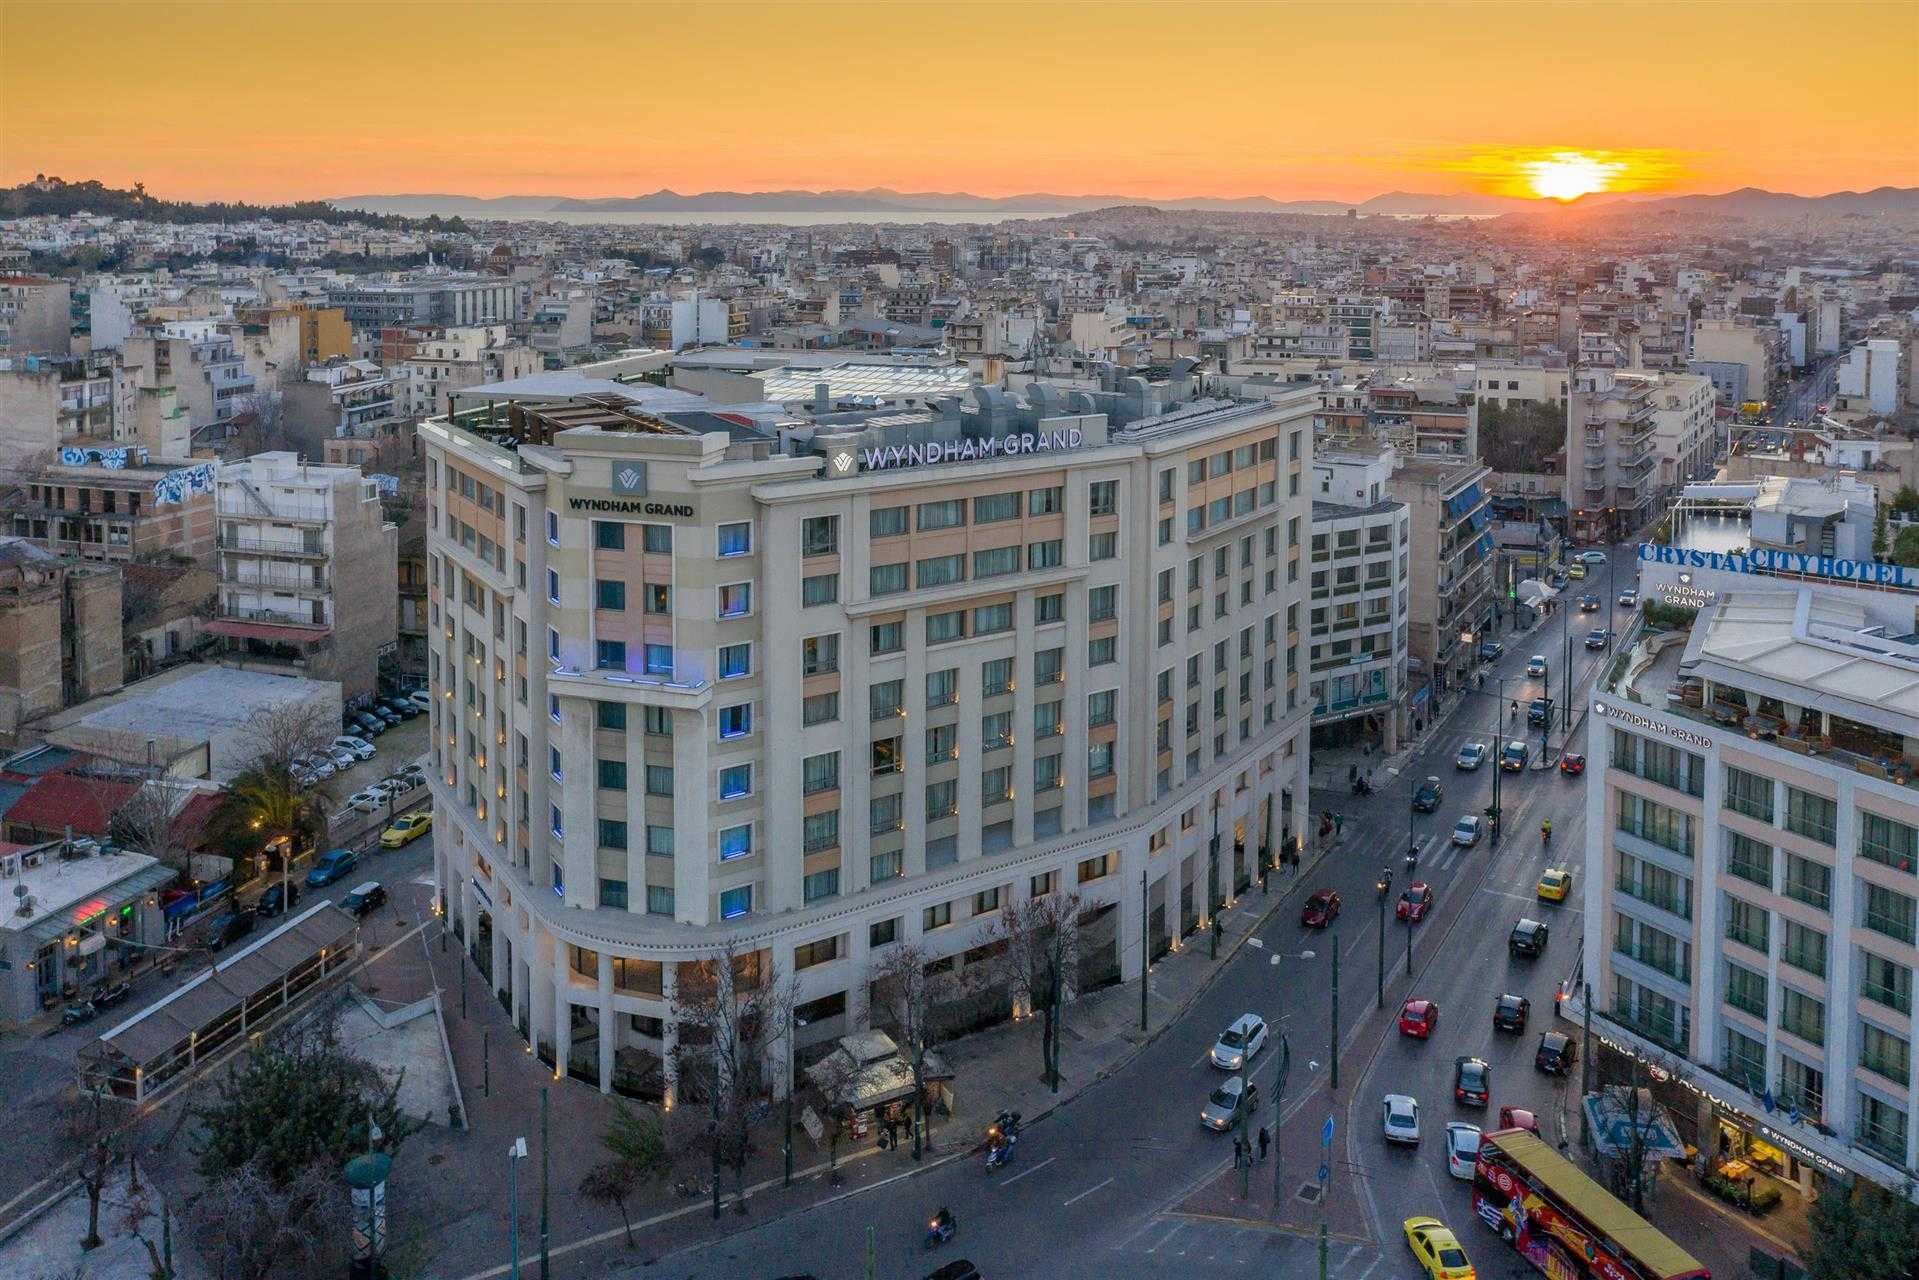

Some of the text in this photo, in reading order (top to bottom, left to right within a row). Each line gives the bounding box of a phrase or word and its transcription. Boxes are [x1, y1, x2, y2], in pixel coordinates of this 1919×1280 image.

[863, 428, 1082, 470] WYNDHAM GRAND
[569, 498, 694, 517] WYNDHAM GRAND
[1639, 543, 1912, 587] CRYSTAL CITY HOTEL
[1656, 583, 1715, 599] WYNDHAM
[1664, 595, 1705, 608] GRAND
[1608, 706, 1712, 749] WYNDHAM GRAND
[1771, 1131, 1846, 1176] WYNDHAM GRAND
